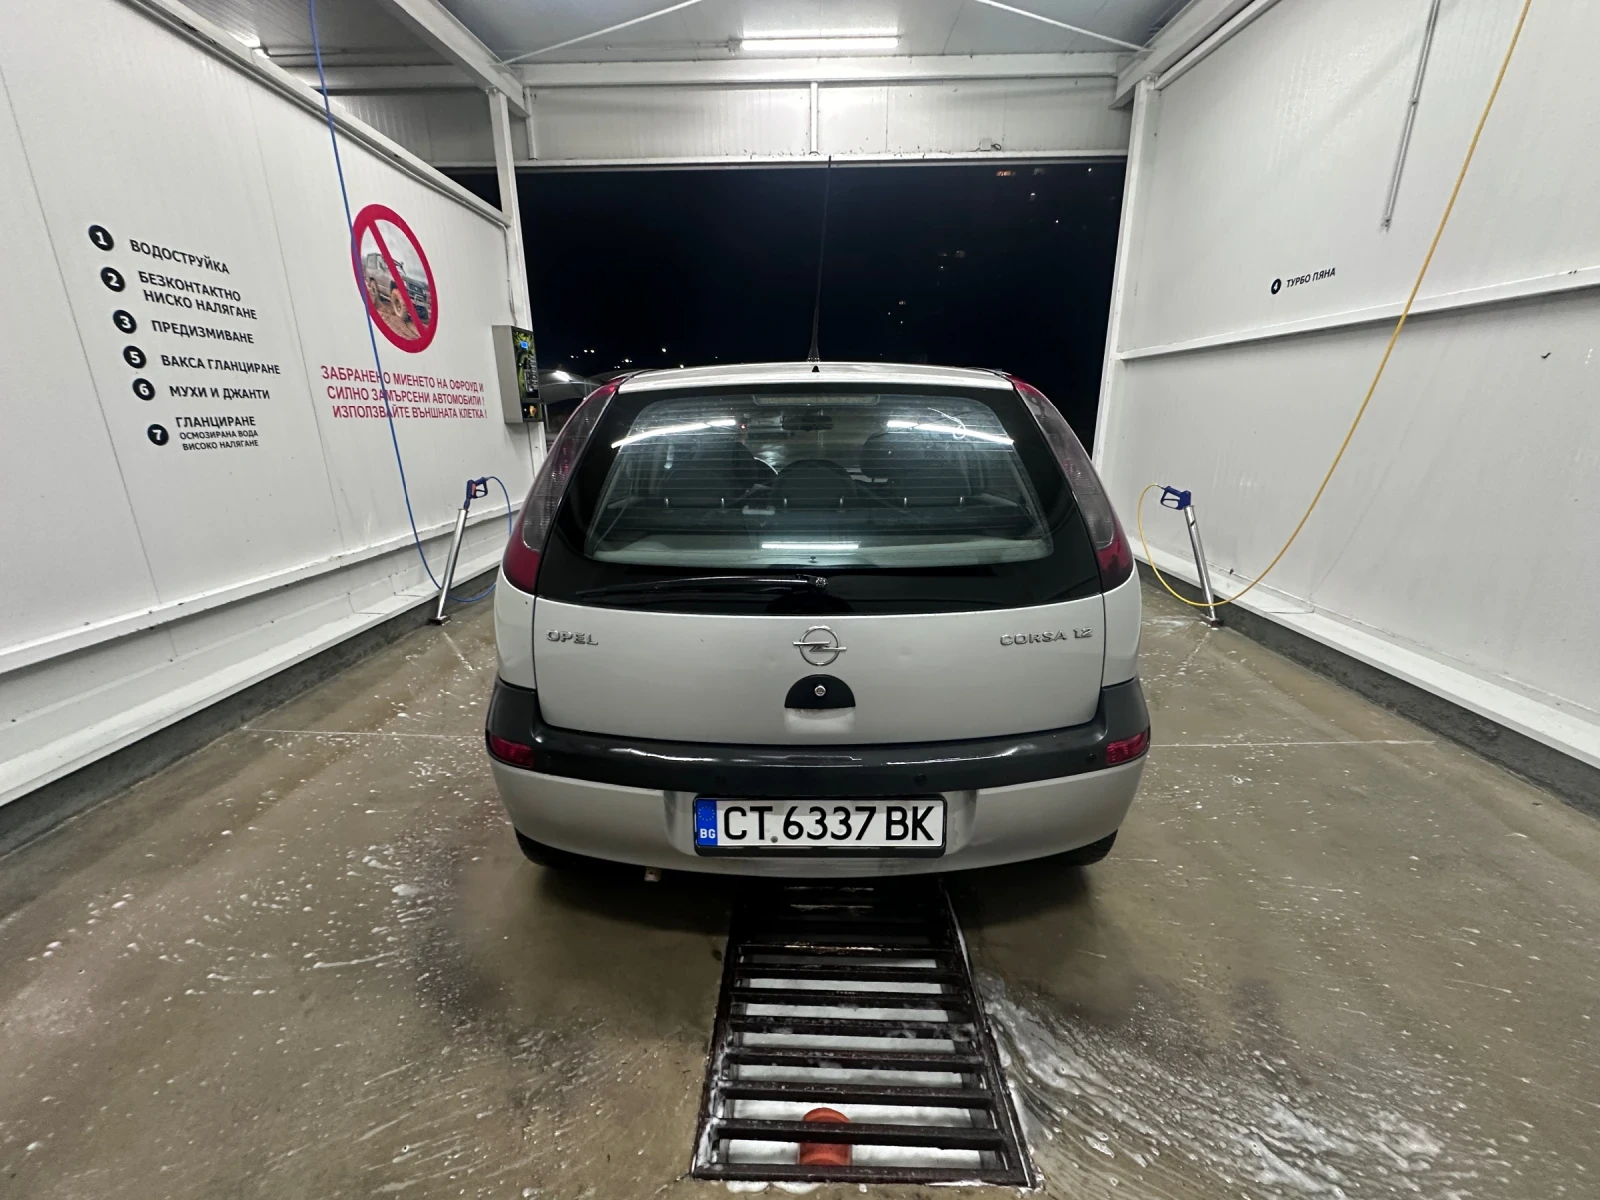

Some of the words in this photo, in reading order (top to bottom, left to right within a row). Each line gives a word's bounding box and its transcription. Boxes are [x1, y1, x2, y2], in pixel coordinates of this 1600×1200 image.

[129, 239, 230, 274] ВОДОСТРУЙКА
[138, 270, 241, 302] БЕЗКОНТАКТНО
[1286, 273, 1311, 288] ТУРБО
[1312, 267, 1336, 282] ПЯНА
[143, 289, 193, 309] НИСКО
[195, 299, 258, 320] НАЛЯГАНЕ
[151, 319, 255, 344] ПРЕДИЗМИВАНЕ
[161, 354, 205, 370] ВАКСА
[207, 358, 281, 375] ГЛАНЦИРАНЕ
[393, 373, 435, 388] МИЕНЕТО
[436, 377, 448, 389] НА
[449, 379, 478, 393] ОФРОУД
[478, 383, 484, 393] И
[169, 386, 207, 398] МУХИ
[210, 388, 220, 399] И
[223, 387, 270, 401] ДЖАНТИ
[327, 385, 370, 401] СИЛНО
[371, 388, 431, 404] ЗАМЪРСЕНИ
[432, 393, 481, 406] АВТОМОБИЛИ
[175, 416, 257, 429] ГЛАНЦИРАНЕ
[412, 406, 458, 419] ВЪНШНАТА
[459, 408, 484, 419] КЛЕТКА
[179, 431, 236, 440] ОСМОЗИРАНА
[237, 429, 259, 438] ВОДА
[182, 441, 218, 451] ВИСОКО
[219, 439, 259, 449] НАЛЯГАНЕ
[546, 630, 599, 646] OPEL
[1000, 630, 1067, 646] CORSA
[782, 805, 877, 841] 6337
[699, 828, 716, 839] BG
